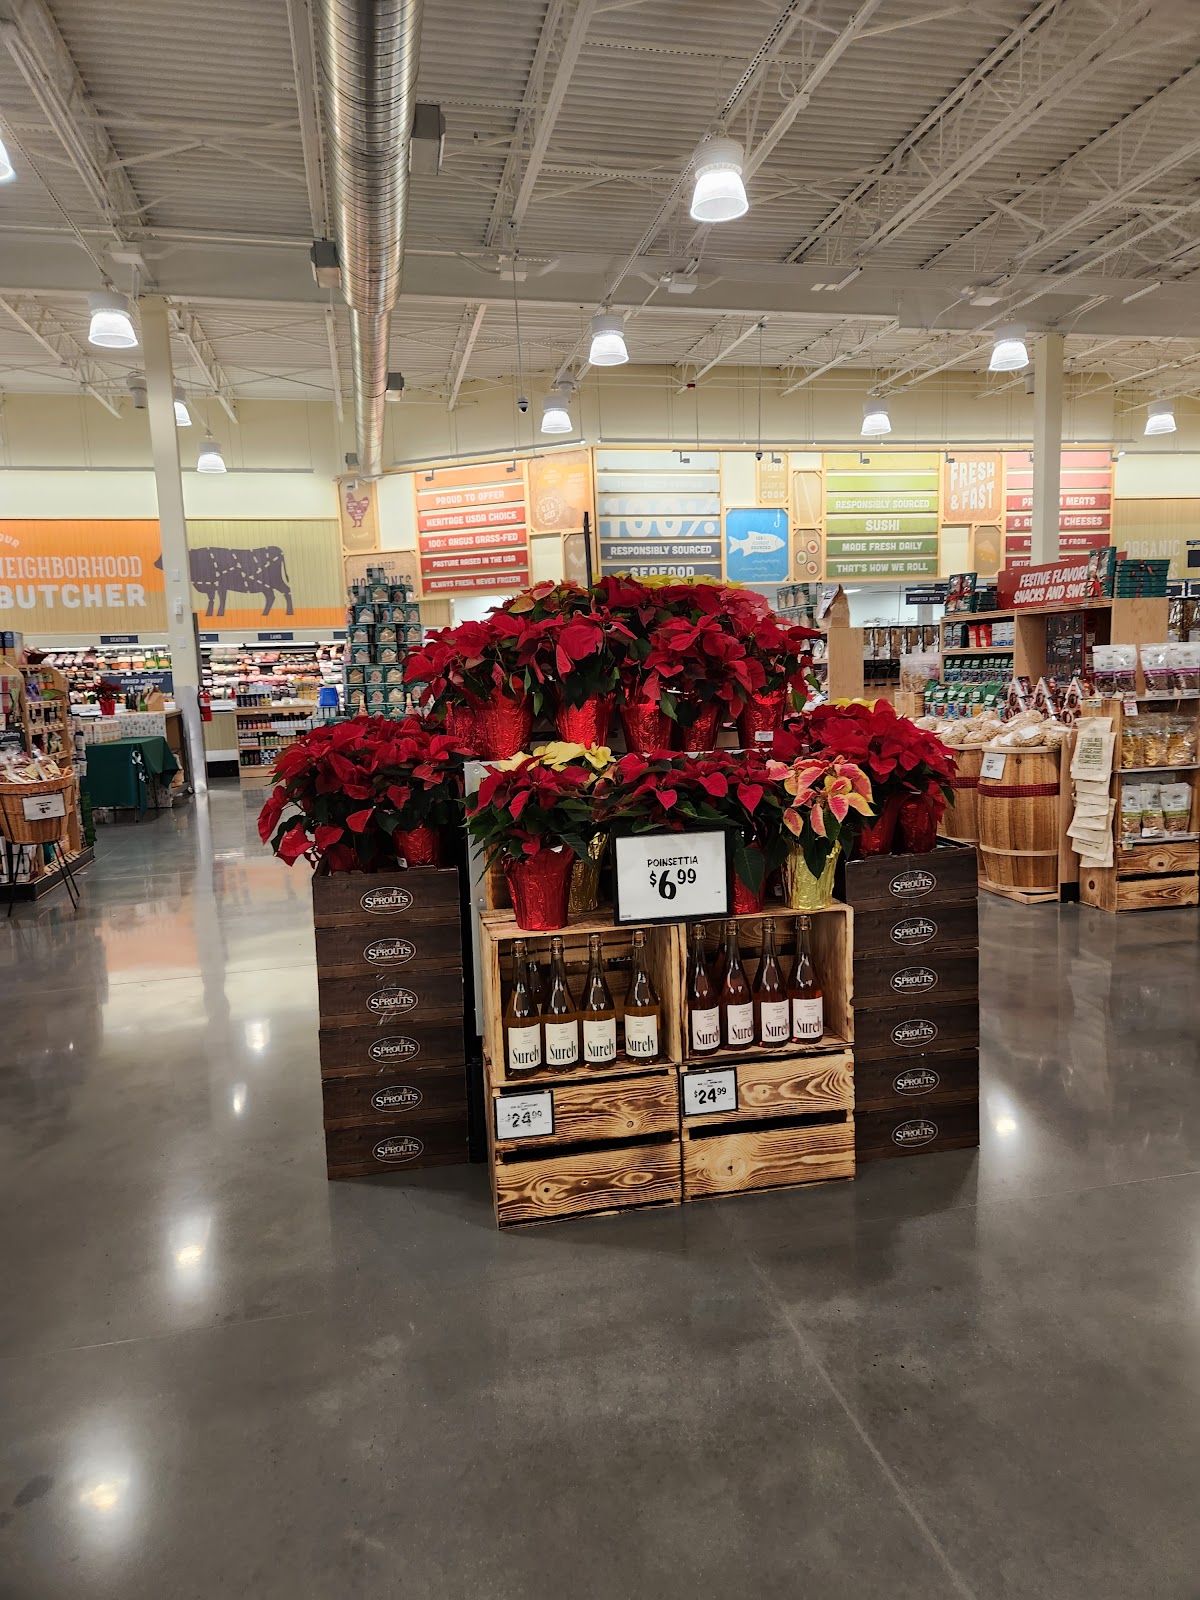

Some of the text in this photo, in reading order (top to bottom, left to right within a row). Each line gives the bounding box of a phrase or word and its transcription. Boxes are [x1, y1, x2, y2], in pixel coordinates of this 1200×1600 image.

[950, 461, 995, 491] FRESH
[435, 490, 504, 505] PROUD TO OFFER
[761, 491, 785, 499] COOK
[950, 494, 959, 511] &
[961, 481, 995, 510] FAST
[1066, 496, 1096, 506] MEATS
[835, 499, 930, 509] RESPONSIBLY SOURCED
[426, 511, 517, 527] HERITAGE USDA CHOICE
[604, 498, 716, 538] 100%
[1014, 518, 1021, 527] &
[1064, 516, 1103, 526] CHEESES
[865, 519, 900, 532] SUSHI
[428, 533, 518, 548] 100% ANGUS GRASS-FED
[841, 541, 923, 552] MADE FRESH DAILY
[610, 545, 712, 555] RESPONSIBLY SOURCED
[432, 559, 459, 568] PASTURE
[460, 558, 481, 566] RAISED
[503, 555, 516, 563] USA
[836, 562, 929, 573] THAT'S HOW WE ROLL
[629, 566, 695, 578] SEAFOOD
[430, 580, 454, 588] ALWAYS
[497, 575, 521, 584] FROZEN
[1019, 571, 1052, 588] FESTIVE
[0, 583, 147, 609] BUTCHER
[1013, 583, 1086, 605] SNACKS AND SWE
[647, 856, 699, 868] POINSETTIA
[732, 1020, 754, 1040] Surel
